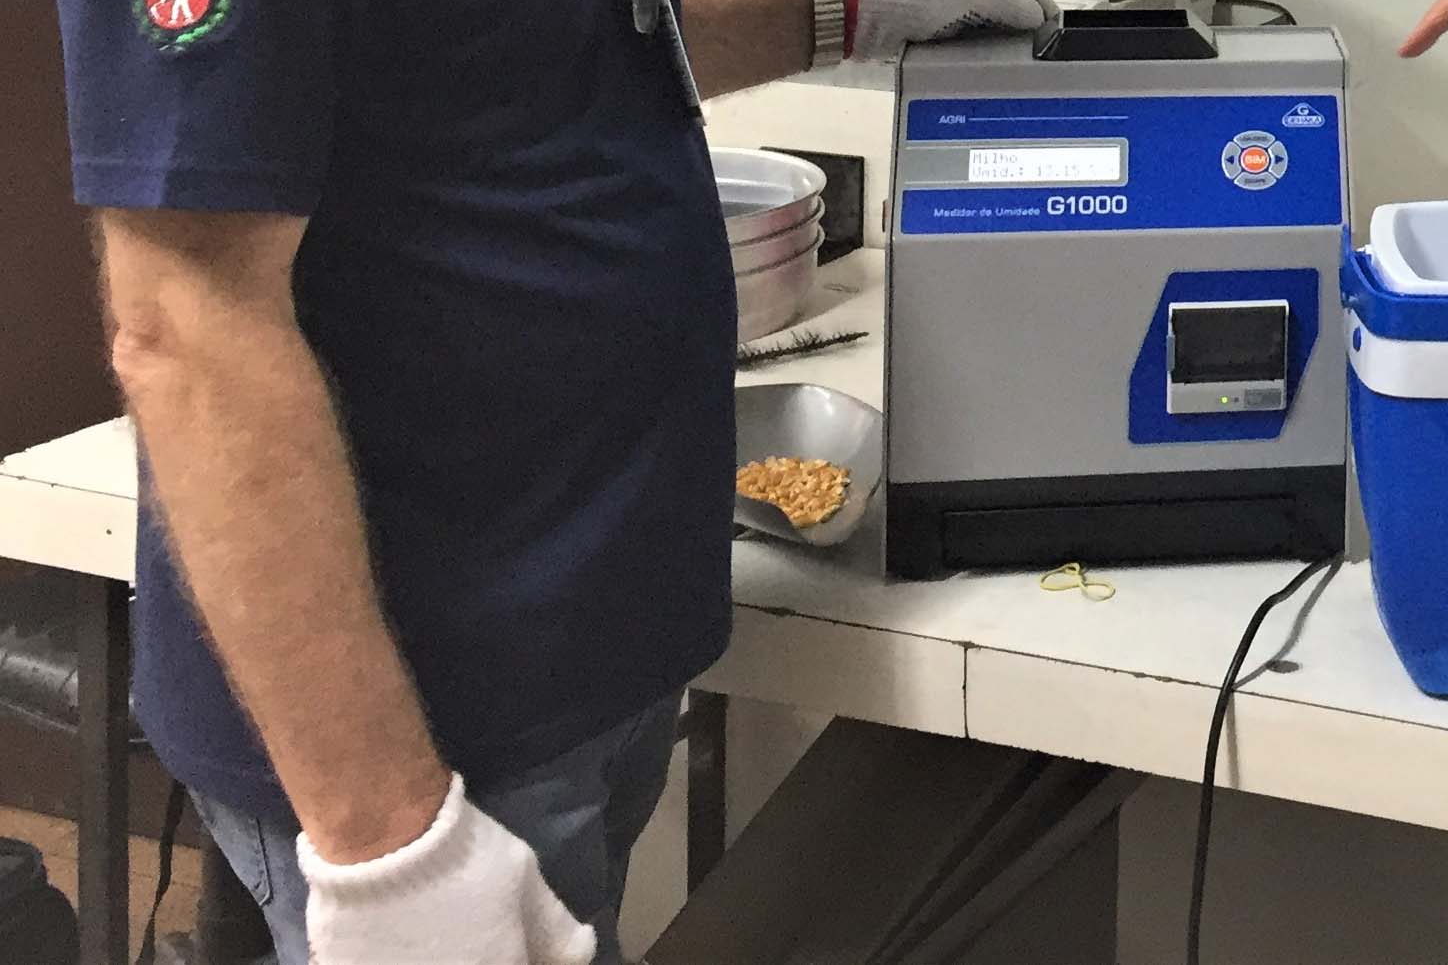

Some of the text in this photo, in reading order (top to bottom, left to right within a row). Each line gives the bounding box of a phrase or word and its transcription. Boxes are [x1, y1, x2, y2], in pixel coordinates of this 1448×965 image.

[1297, 105, 1309, 115] G
[939, 115, 966, 124] AGRI
[973, 152, 1019, 165] Milho
[1244, 154, 1267, 164] SIM
[934, 195, 1127, 217] Medidor de Umidade G1000
